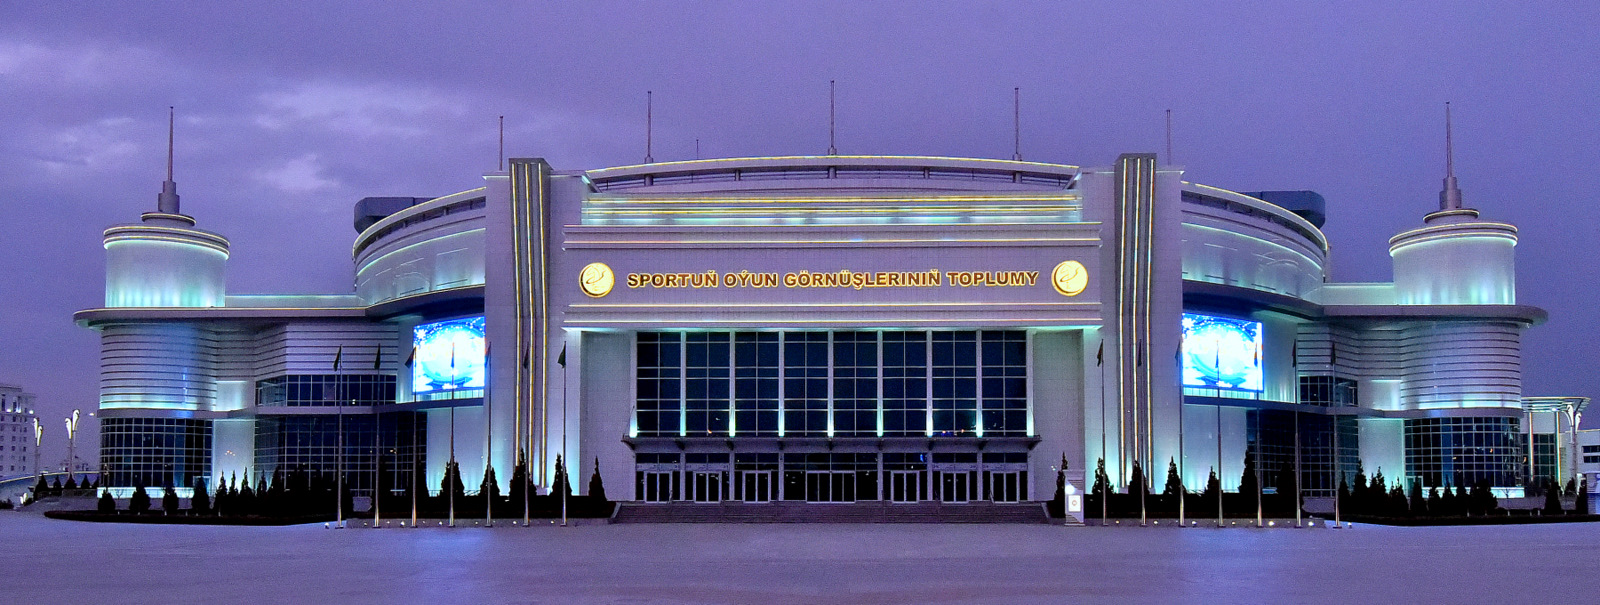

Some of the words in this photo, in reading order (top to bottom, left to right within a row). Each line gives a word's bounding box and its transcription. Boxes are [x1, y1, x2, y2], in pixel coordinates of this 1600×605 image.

[627, 270, 718, 287] SPORTUŇ
[723, 270, 778, 287] OÝUN
[946, 271, 1039, 287] TOPLUMY
